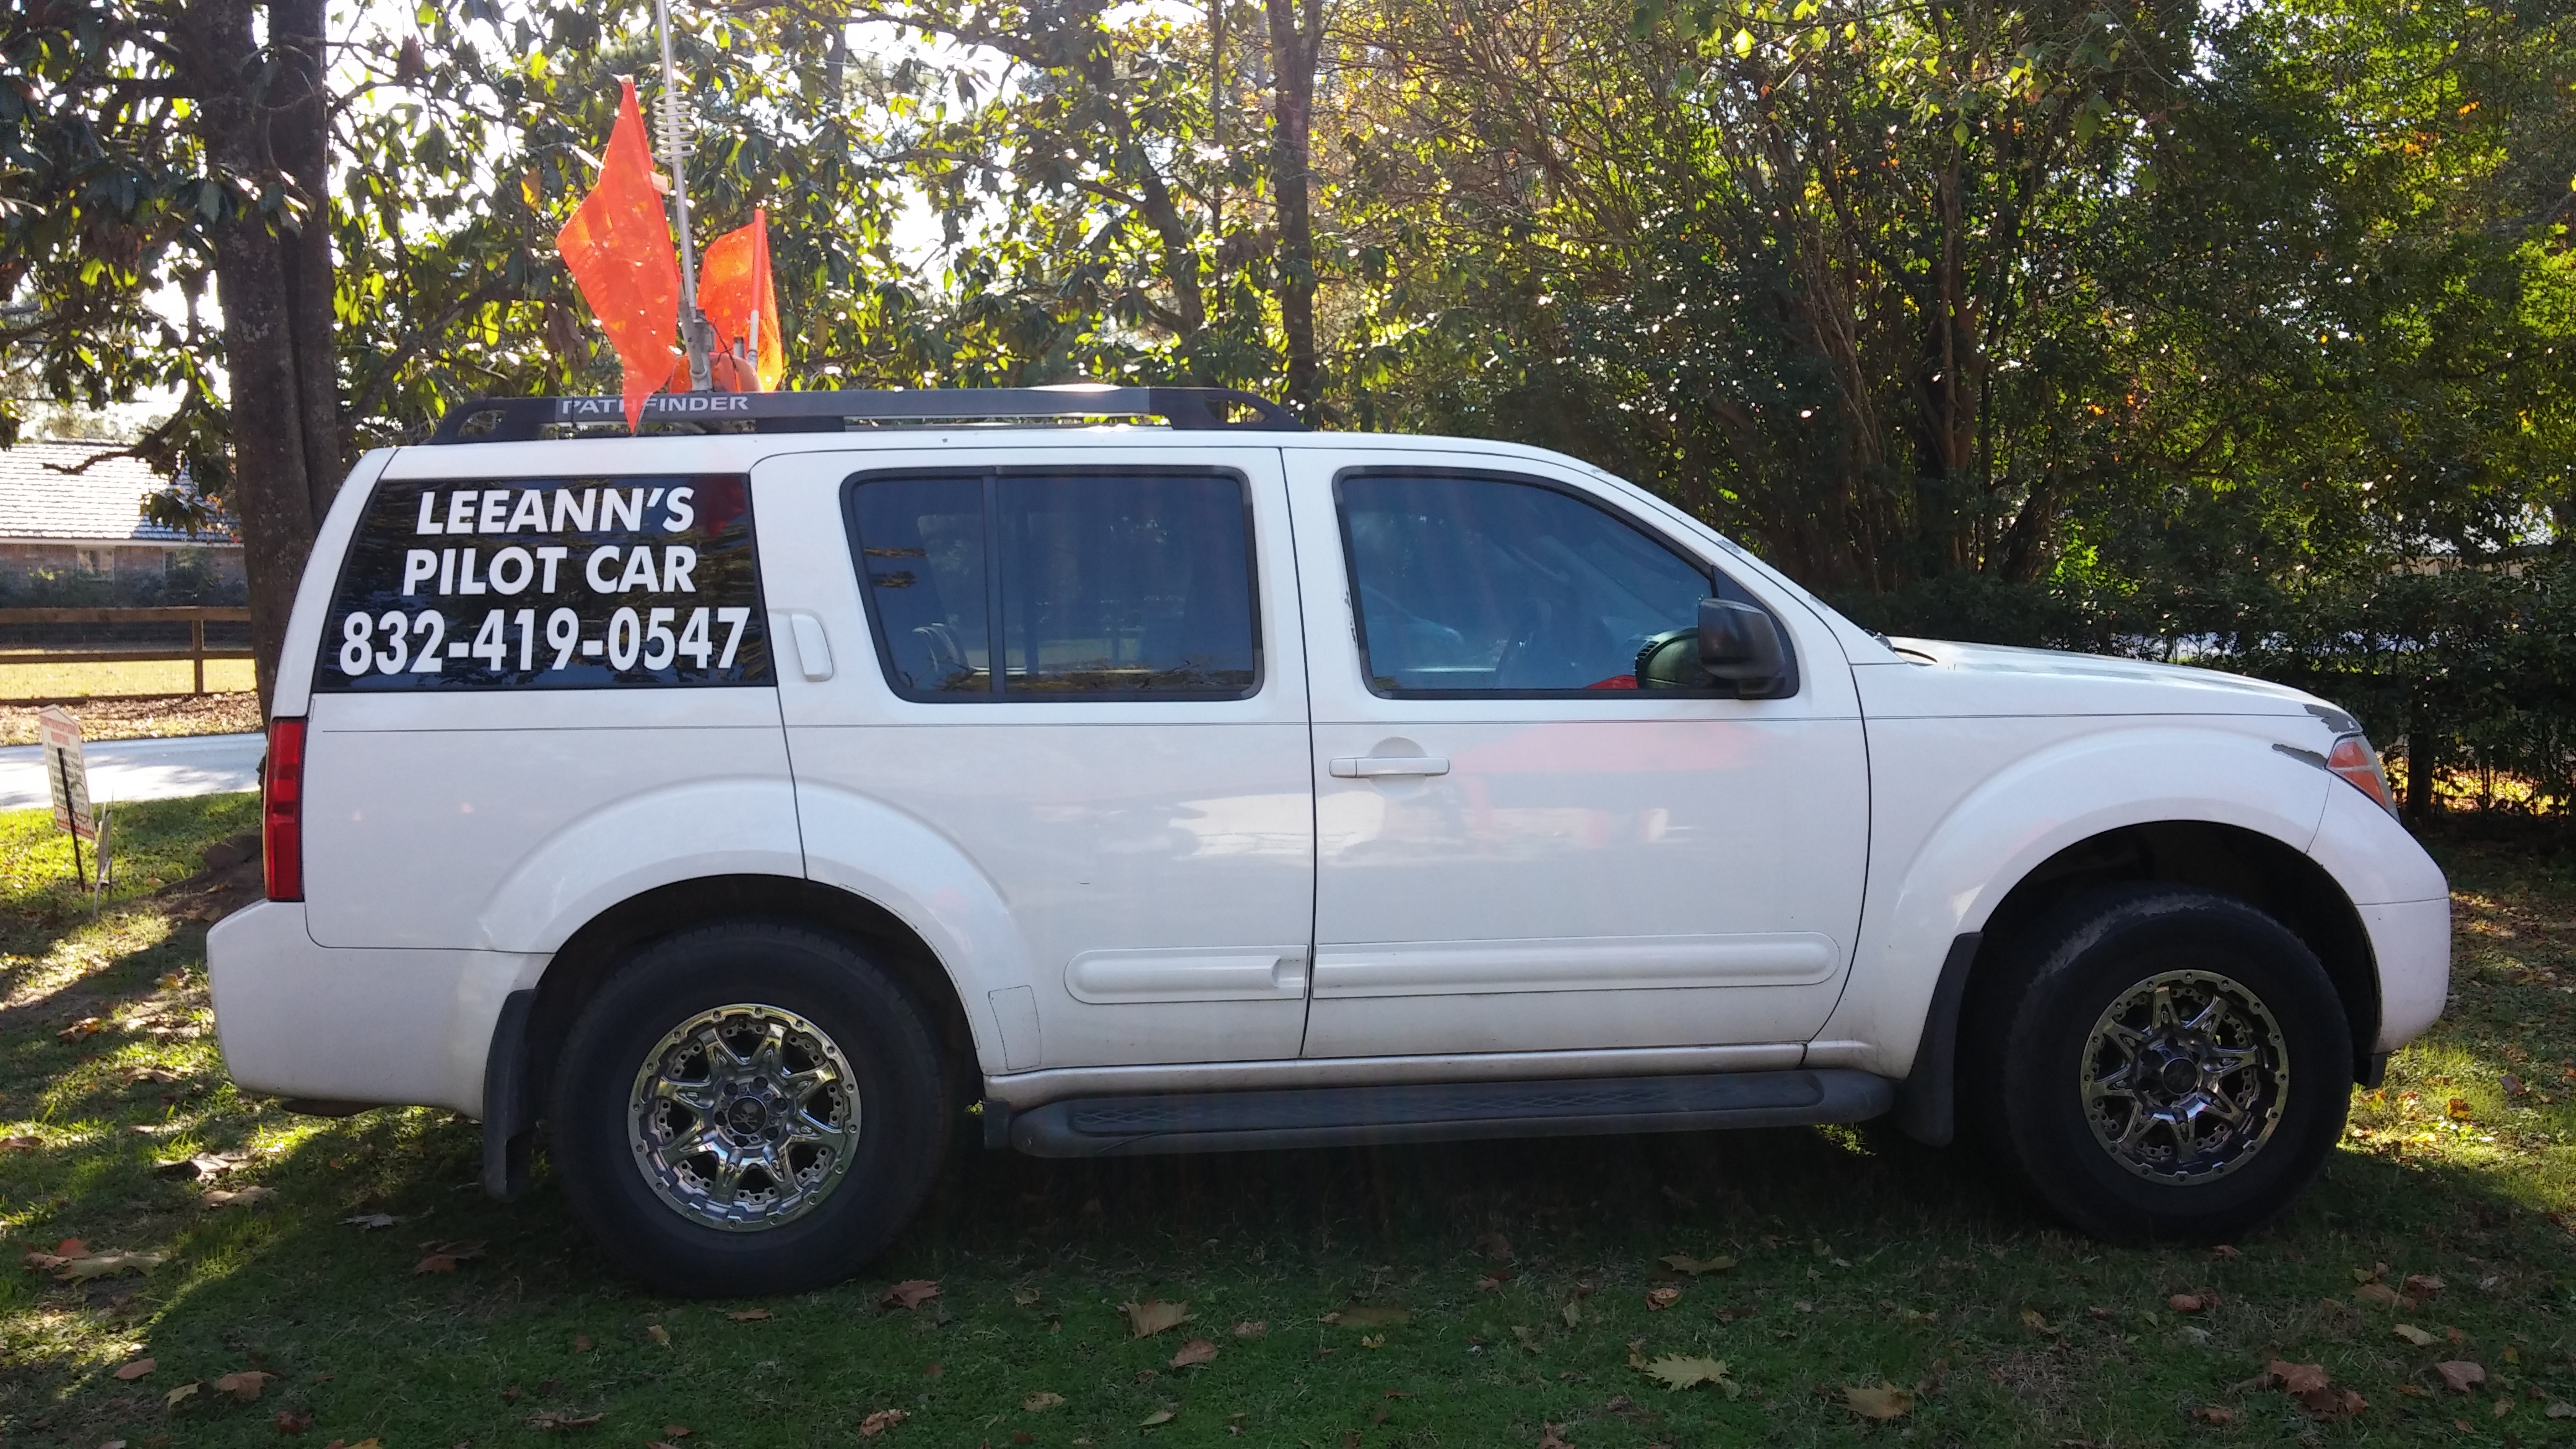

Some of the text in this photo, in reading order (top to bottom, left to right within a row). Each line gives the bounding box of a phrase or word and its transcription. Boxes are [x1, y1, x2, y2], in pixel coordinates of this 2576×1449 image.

[416, 487, 695, 534] LEEANN'S
[402, 545, 697, 596] PILOT CAR
[339, 606, 751, 676] 832-419-0547
